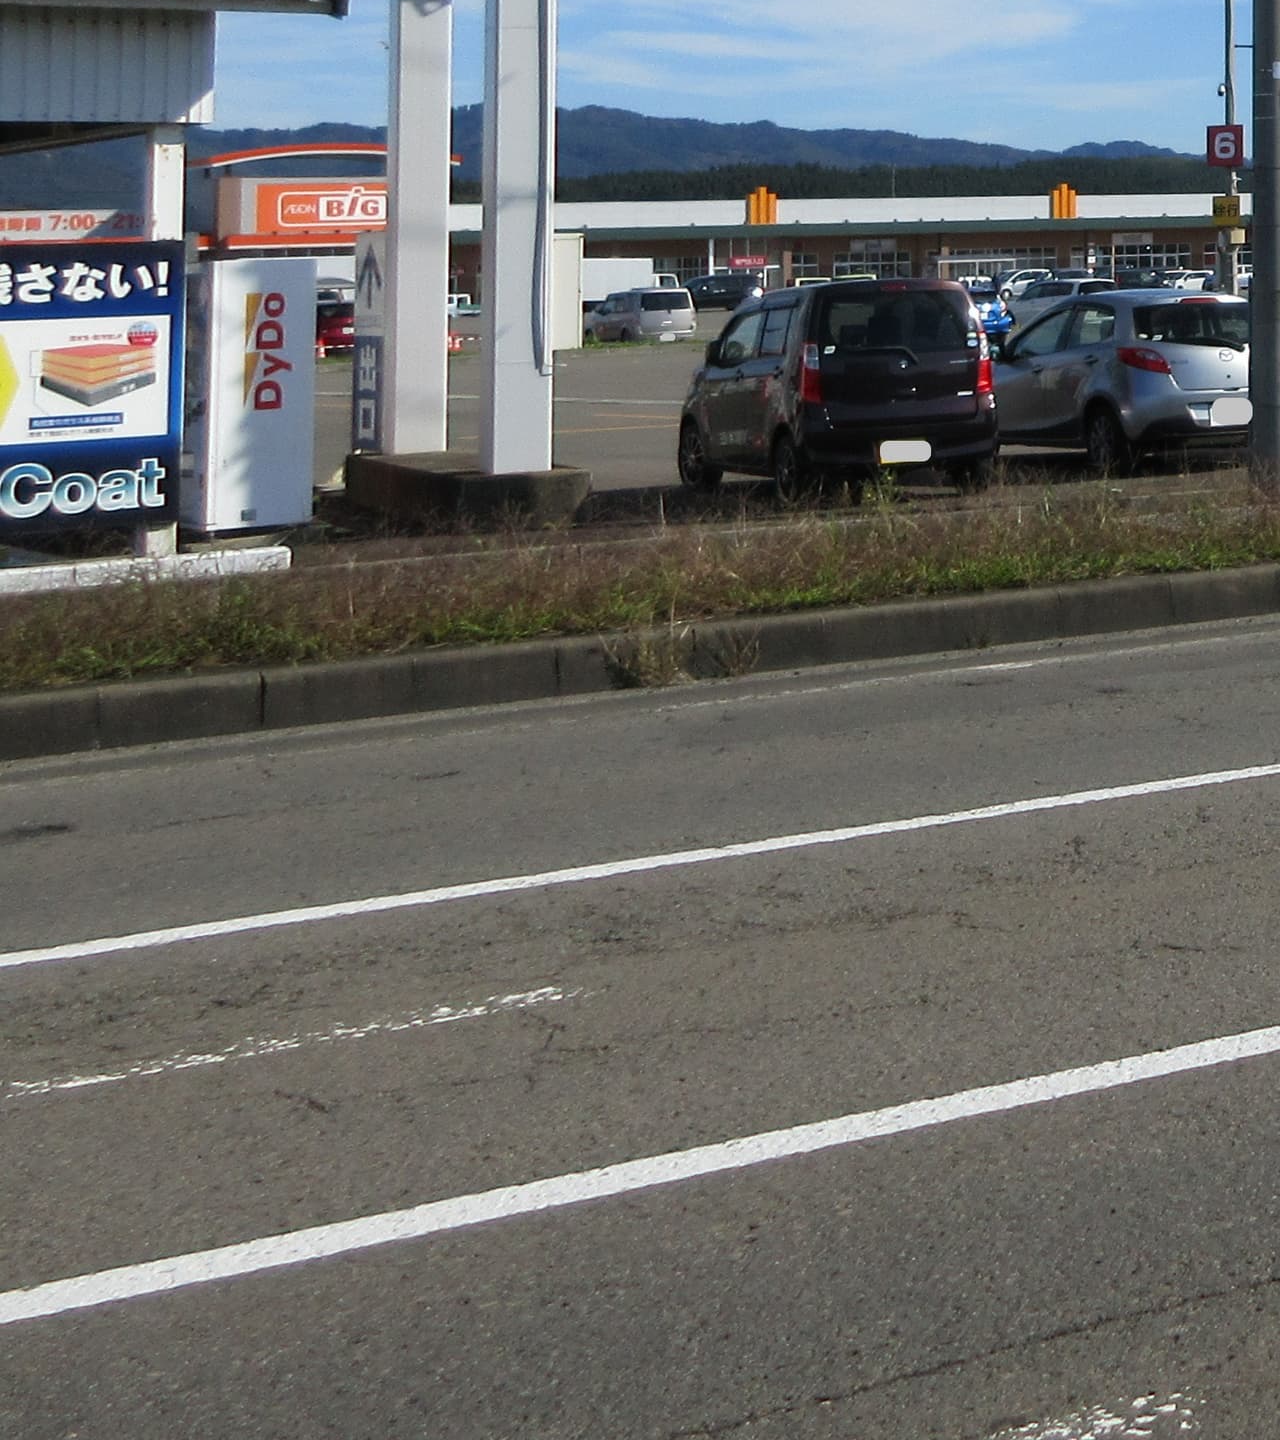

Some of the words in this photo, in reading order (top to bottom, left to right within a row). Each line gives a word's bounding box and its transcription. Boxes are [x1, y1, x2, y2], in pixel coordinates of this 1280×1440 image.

[1214, 132, 1236, 159] 6
[254, 292, 293, 410] DyDo
[358, 344, 376, 441] 出口
[0, 458, 166, 518] Coat
